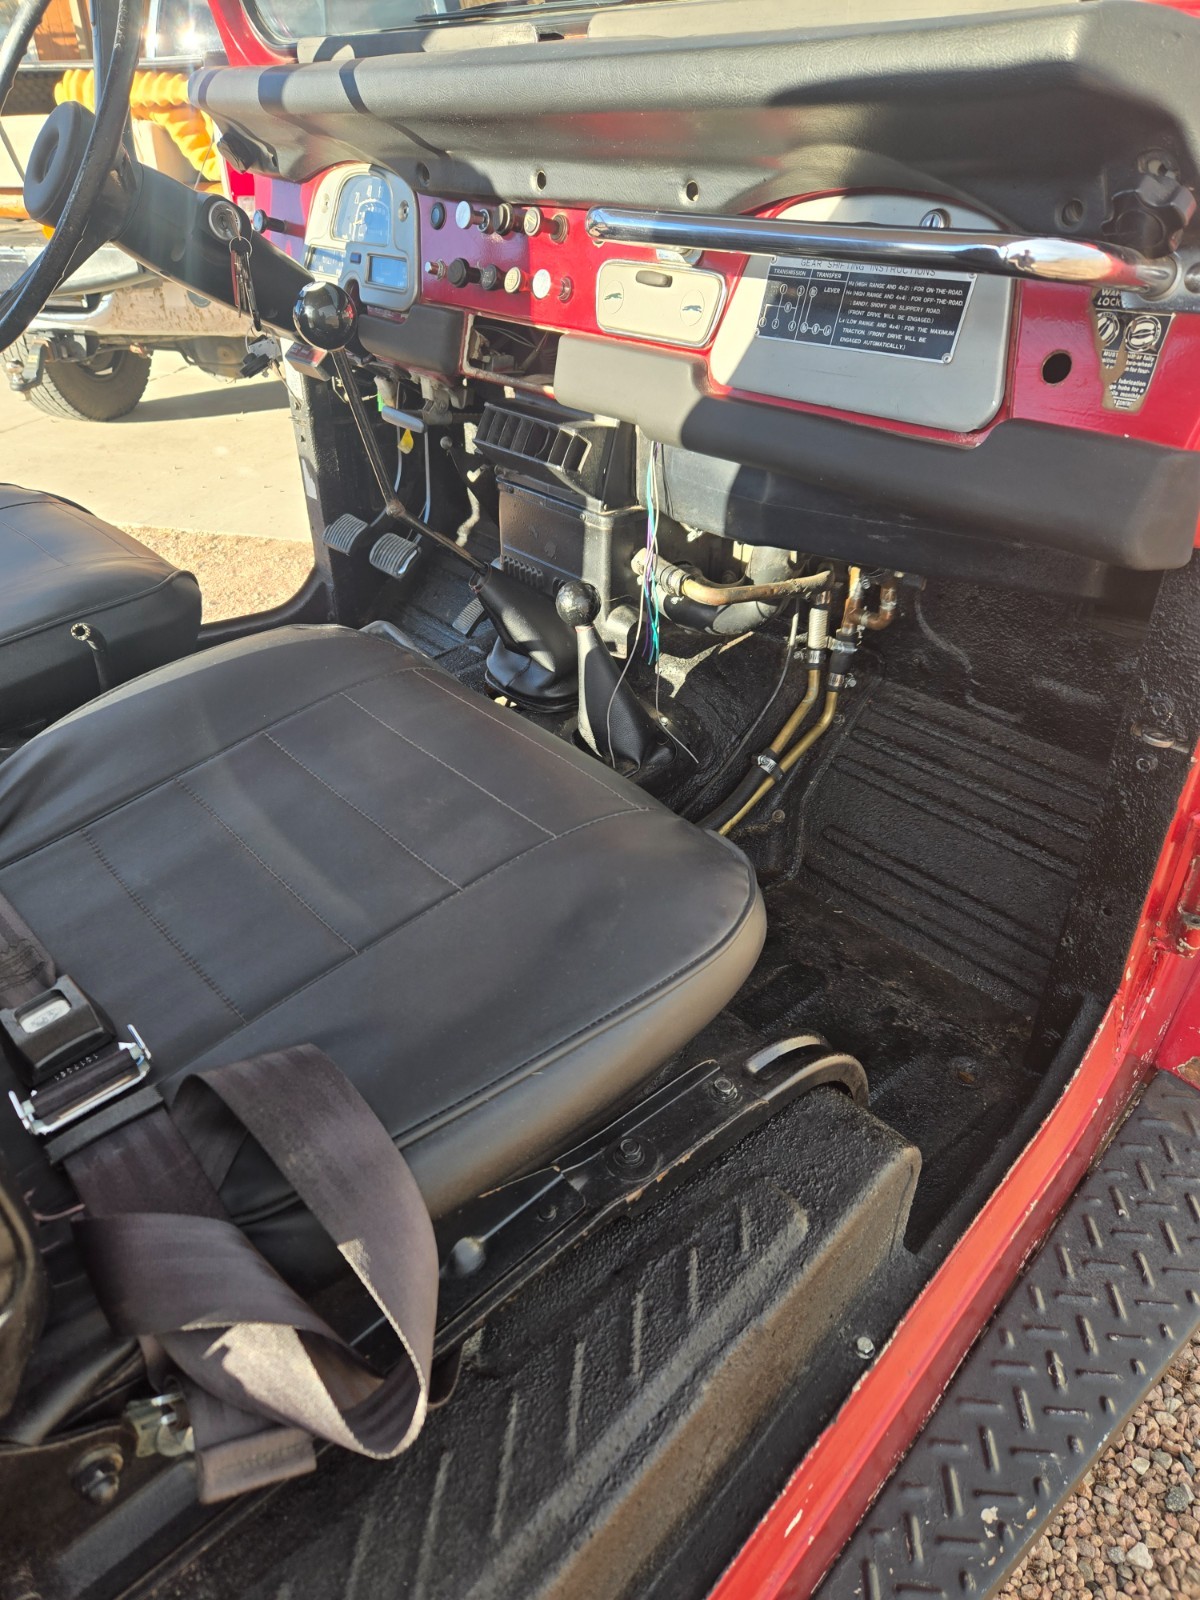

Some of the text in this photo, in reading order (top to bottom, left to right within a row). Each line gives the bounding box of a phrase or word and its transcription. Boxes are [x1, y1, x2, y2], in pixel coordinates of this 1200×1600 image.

[800, 258, 936, 278] GEAR SHIFTING INSTRUCTIONS
[899, 304, 924, 312] SLIPPERY
[930, 328, 955, 336] MAXIMUM
